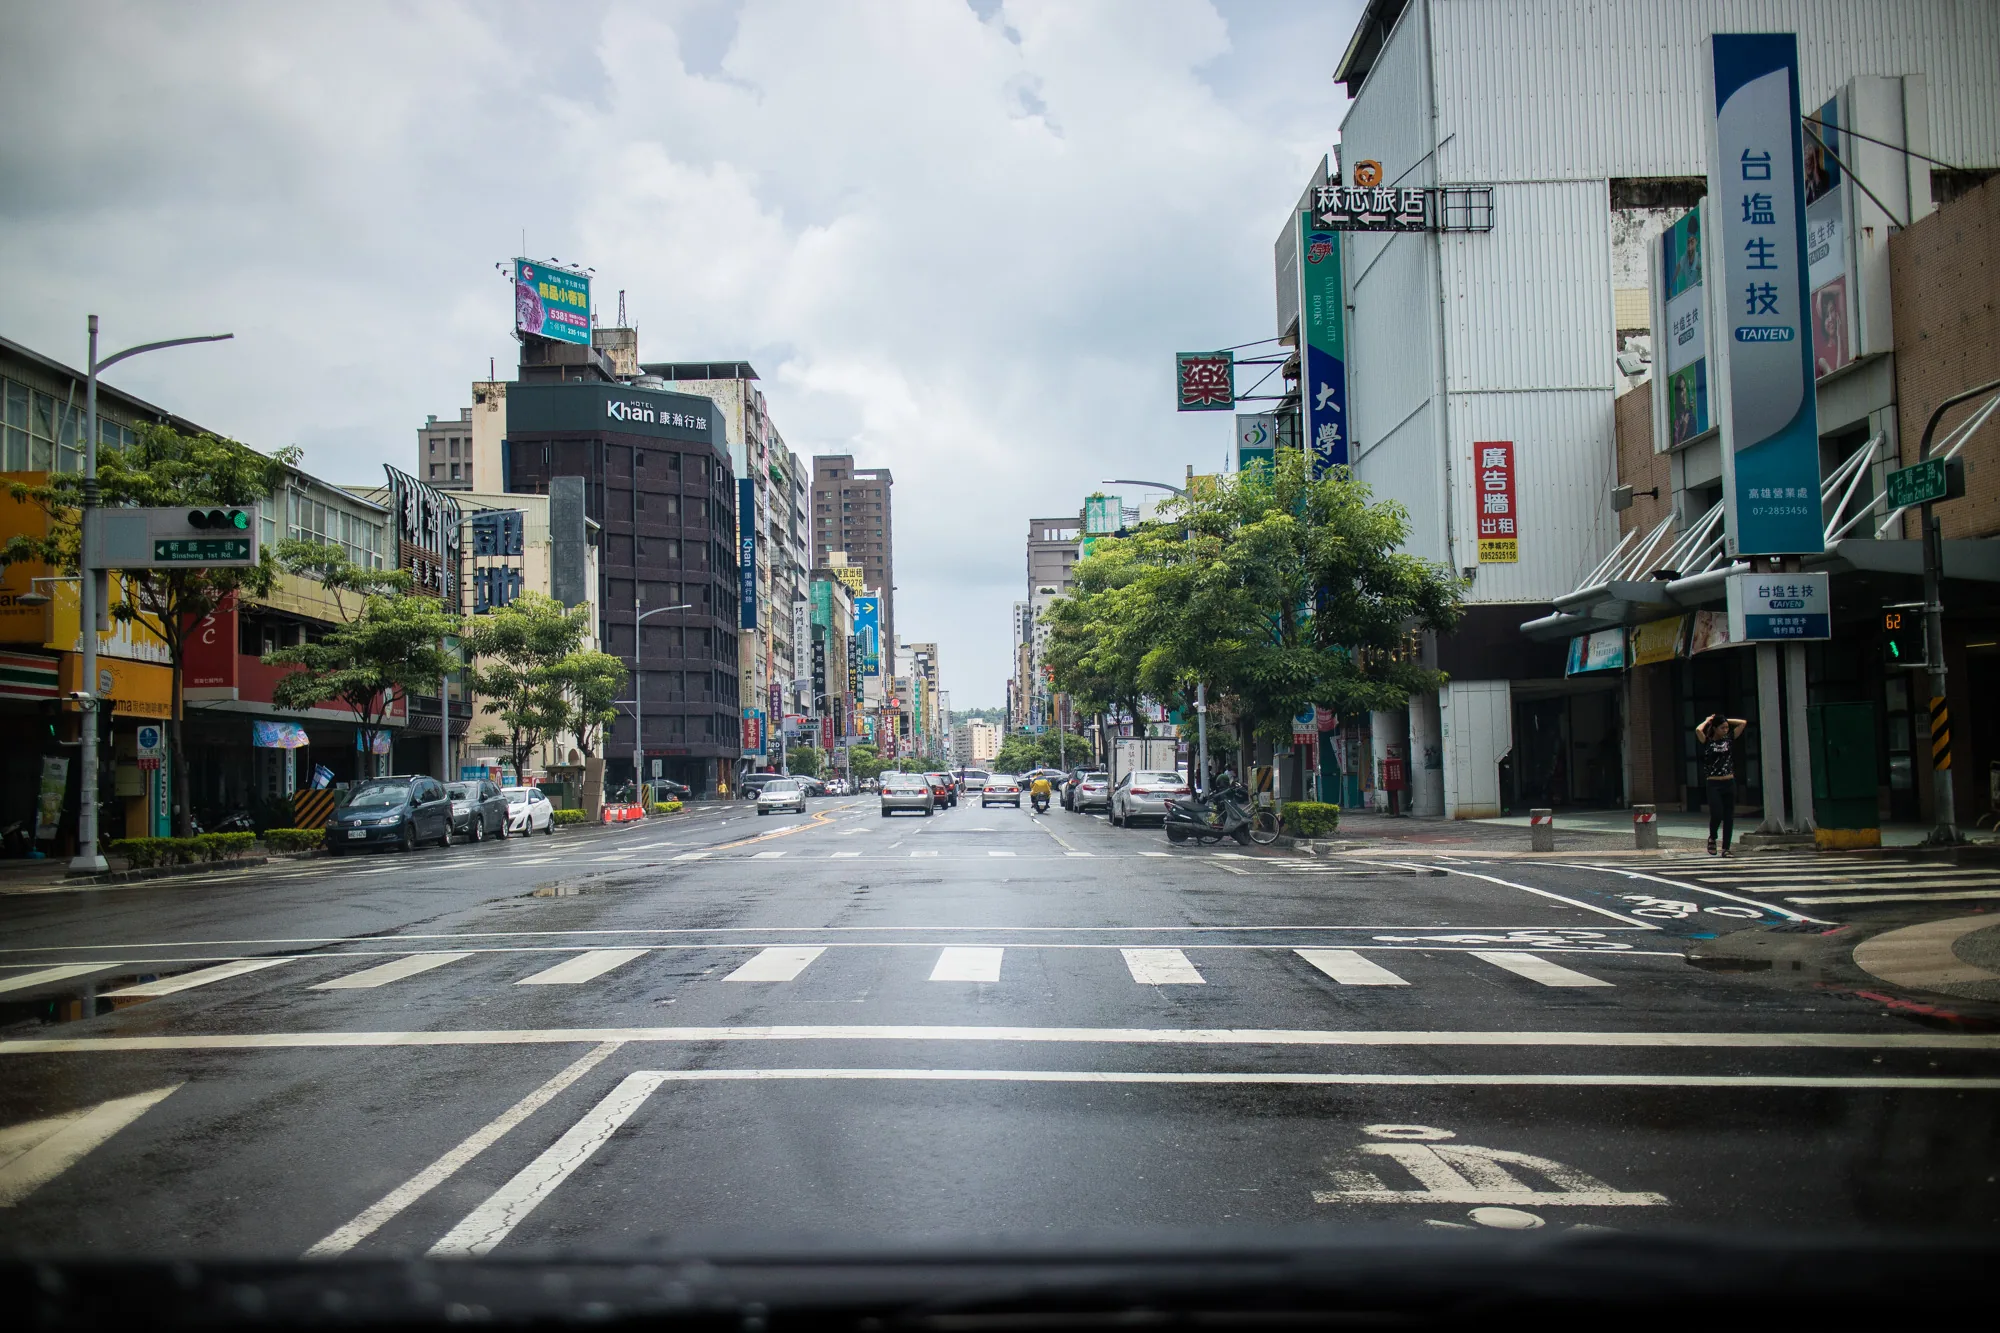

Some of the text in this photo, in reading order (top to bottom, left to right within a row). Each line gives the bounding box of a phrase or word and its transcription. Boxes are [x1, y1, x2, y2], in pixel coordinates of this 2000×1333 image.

[1740, 148, 1780, 316] 台塩生技
[550, 309, 565, 321] 538
[1313, 294, 1322, 326] BOOKS
[1740, 328, 1790, 340] TAIYEN
[1182, 356, 1231, 406] 藥
[630, 401, 654, 409] HOTEL
[607, 400, 707, 430] Khan 康瀚行旅
[1314, 382, 1342, 480] 大學
[1482, 447, 1509, 515] 廣告牆
[1894, 463, 1936, 490] 七賢二路
[1748, 487, 1808, 500] 高雄營業處
[1914, 485, 1925, 500] 2nd
[1752, 504, 1808, 516] 07-2853456
[1481, 518, 1515, 534] 出租
[743, 538, 753, 567] Khan
[1481, 541, 1516, 551] 大學城內洽
[171, 552, 204, 561] Sinsheng
[207, 552, 218, 560] 1st
[1480, 550, 1517, 560] 0952525156
[744, 572, 753, 604] 康瀚行旅
[1758, 585, 1814, 598] 台塩生技
[1771, 600, 1802, 608] TAIYEN
[1886, 613, 1901, 630] 62
[1772, 626, 1804, 635] 特約商店
[112, 699, 132, 713] ama
